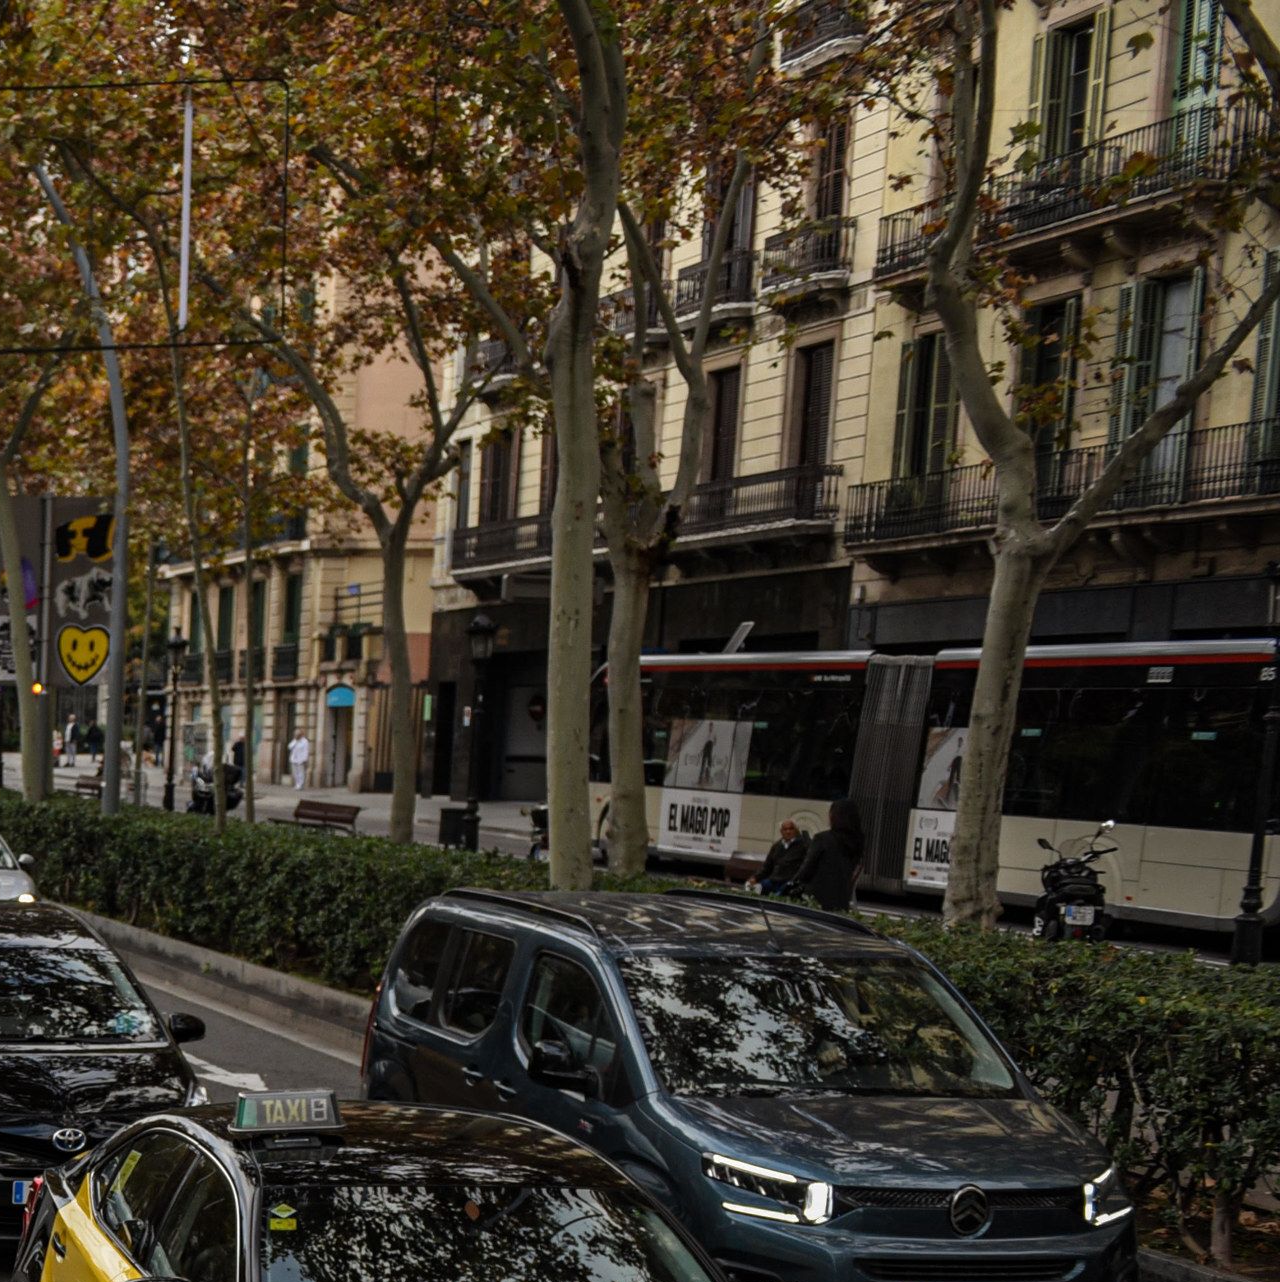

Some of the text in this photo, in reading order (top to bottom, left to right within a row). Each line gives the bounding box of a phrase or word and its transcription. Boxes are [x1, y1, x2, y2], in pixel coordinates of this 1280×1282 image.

[668, 803, 731, 837] EL MAGO POP
[913, 837, 951, 864] EL MAG
[262, 1098, 307, 1124] TAXI
